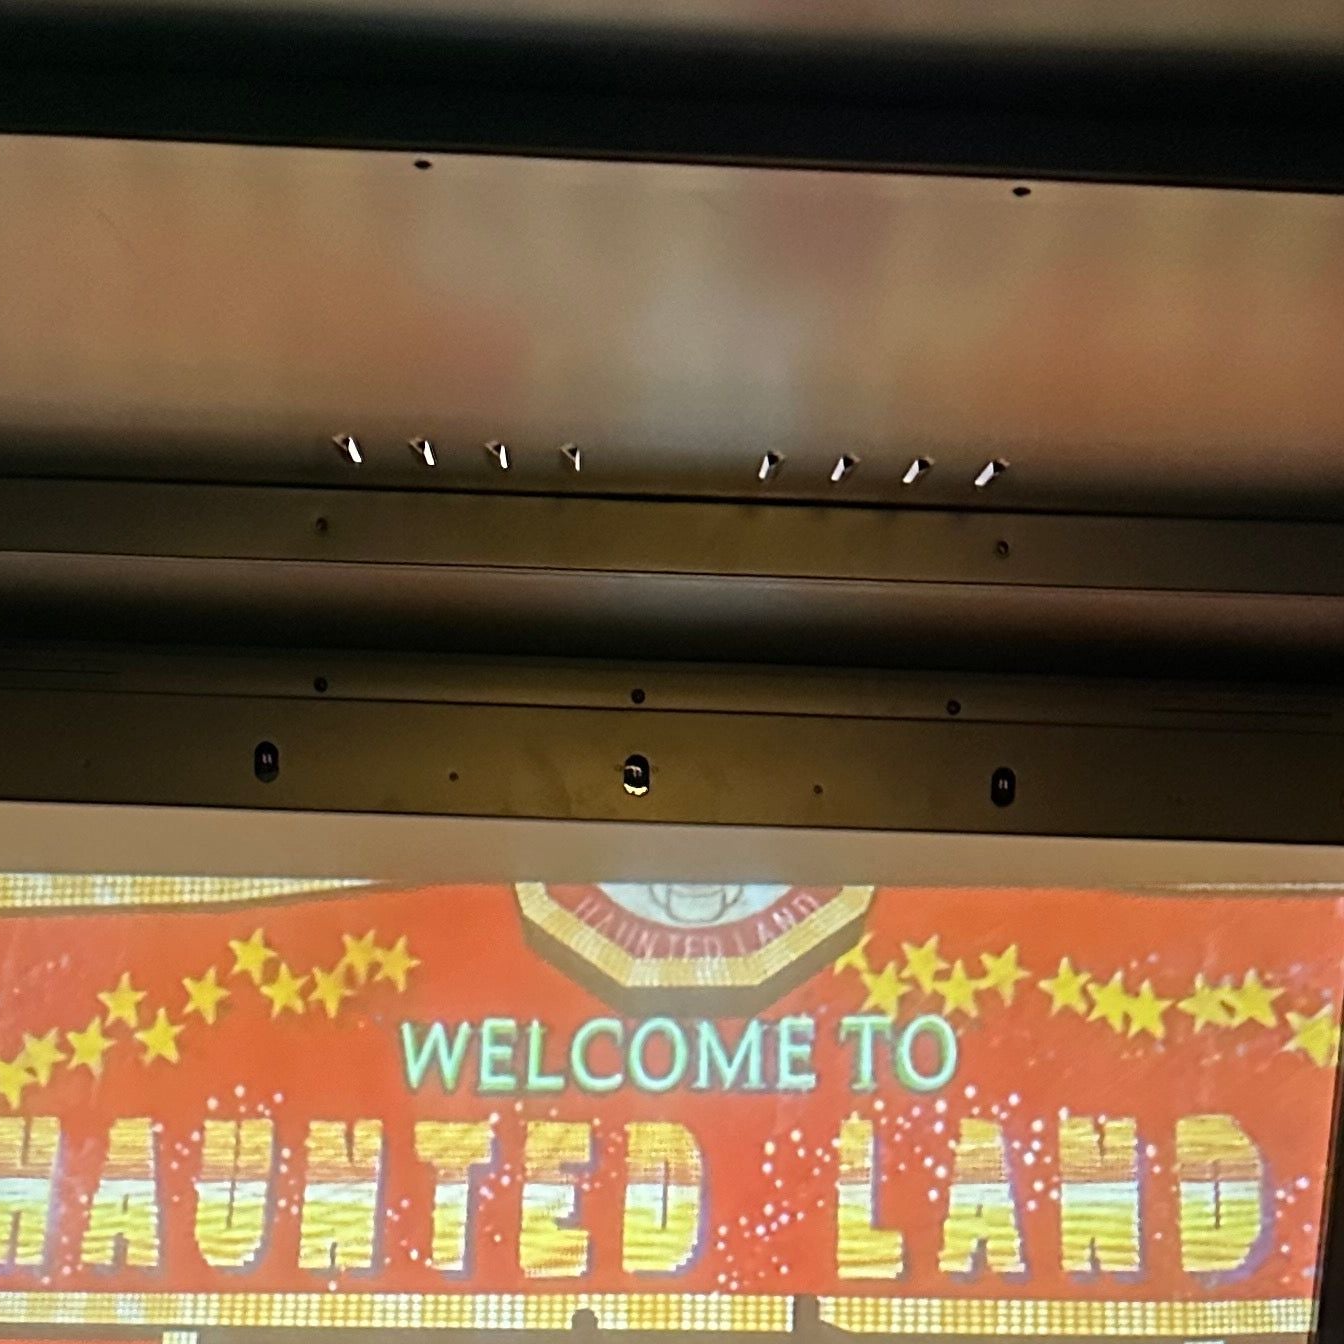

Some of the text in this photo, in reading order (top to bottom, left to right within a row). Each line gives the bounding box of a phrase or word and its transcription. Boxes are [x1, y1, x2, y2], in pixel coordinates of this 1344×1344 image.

[401, 1014, 958, 1094] WELCOME TO
[836, 1113, 1268, 1281] LAND
